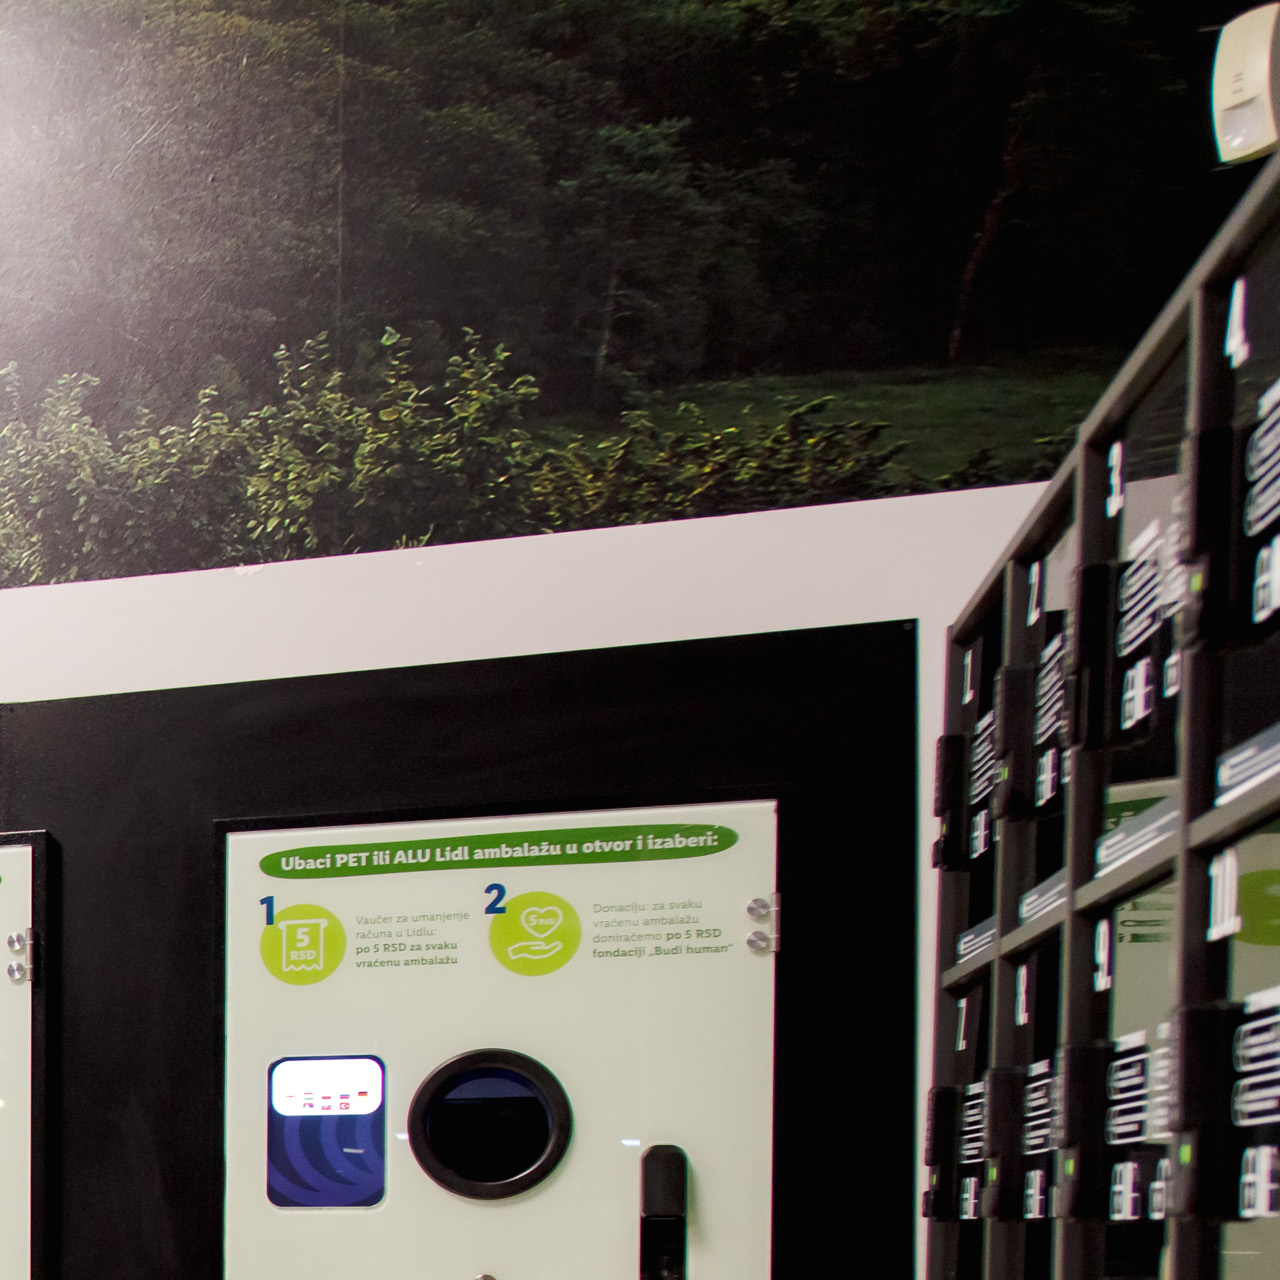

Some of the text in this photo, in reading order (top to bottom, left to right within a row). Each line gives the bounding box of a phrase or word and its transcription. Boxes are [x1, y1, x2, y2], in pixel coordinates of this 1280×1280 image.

[281, 831, 718, 871] Ubaci PET ili ALU Lidl ambalažu u otvor i izaberi:
[259, 896, 275, 925] 1
[484, 883, 507, 914] 2
